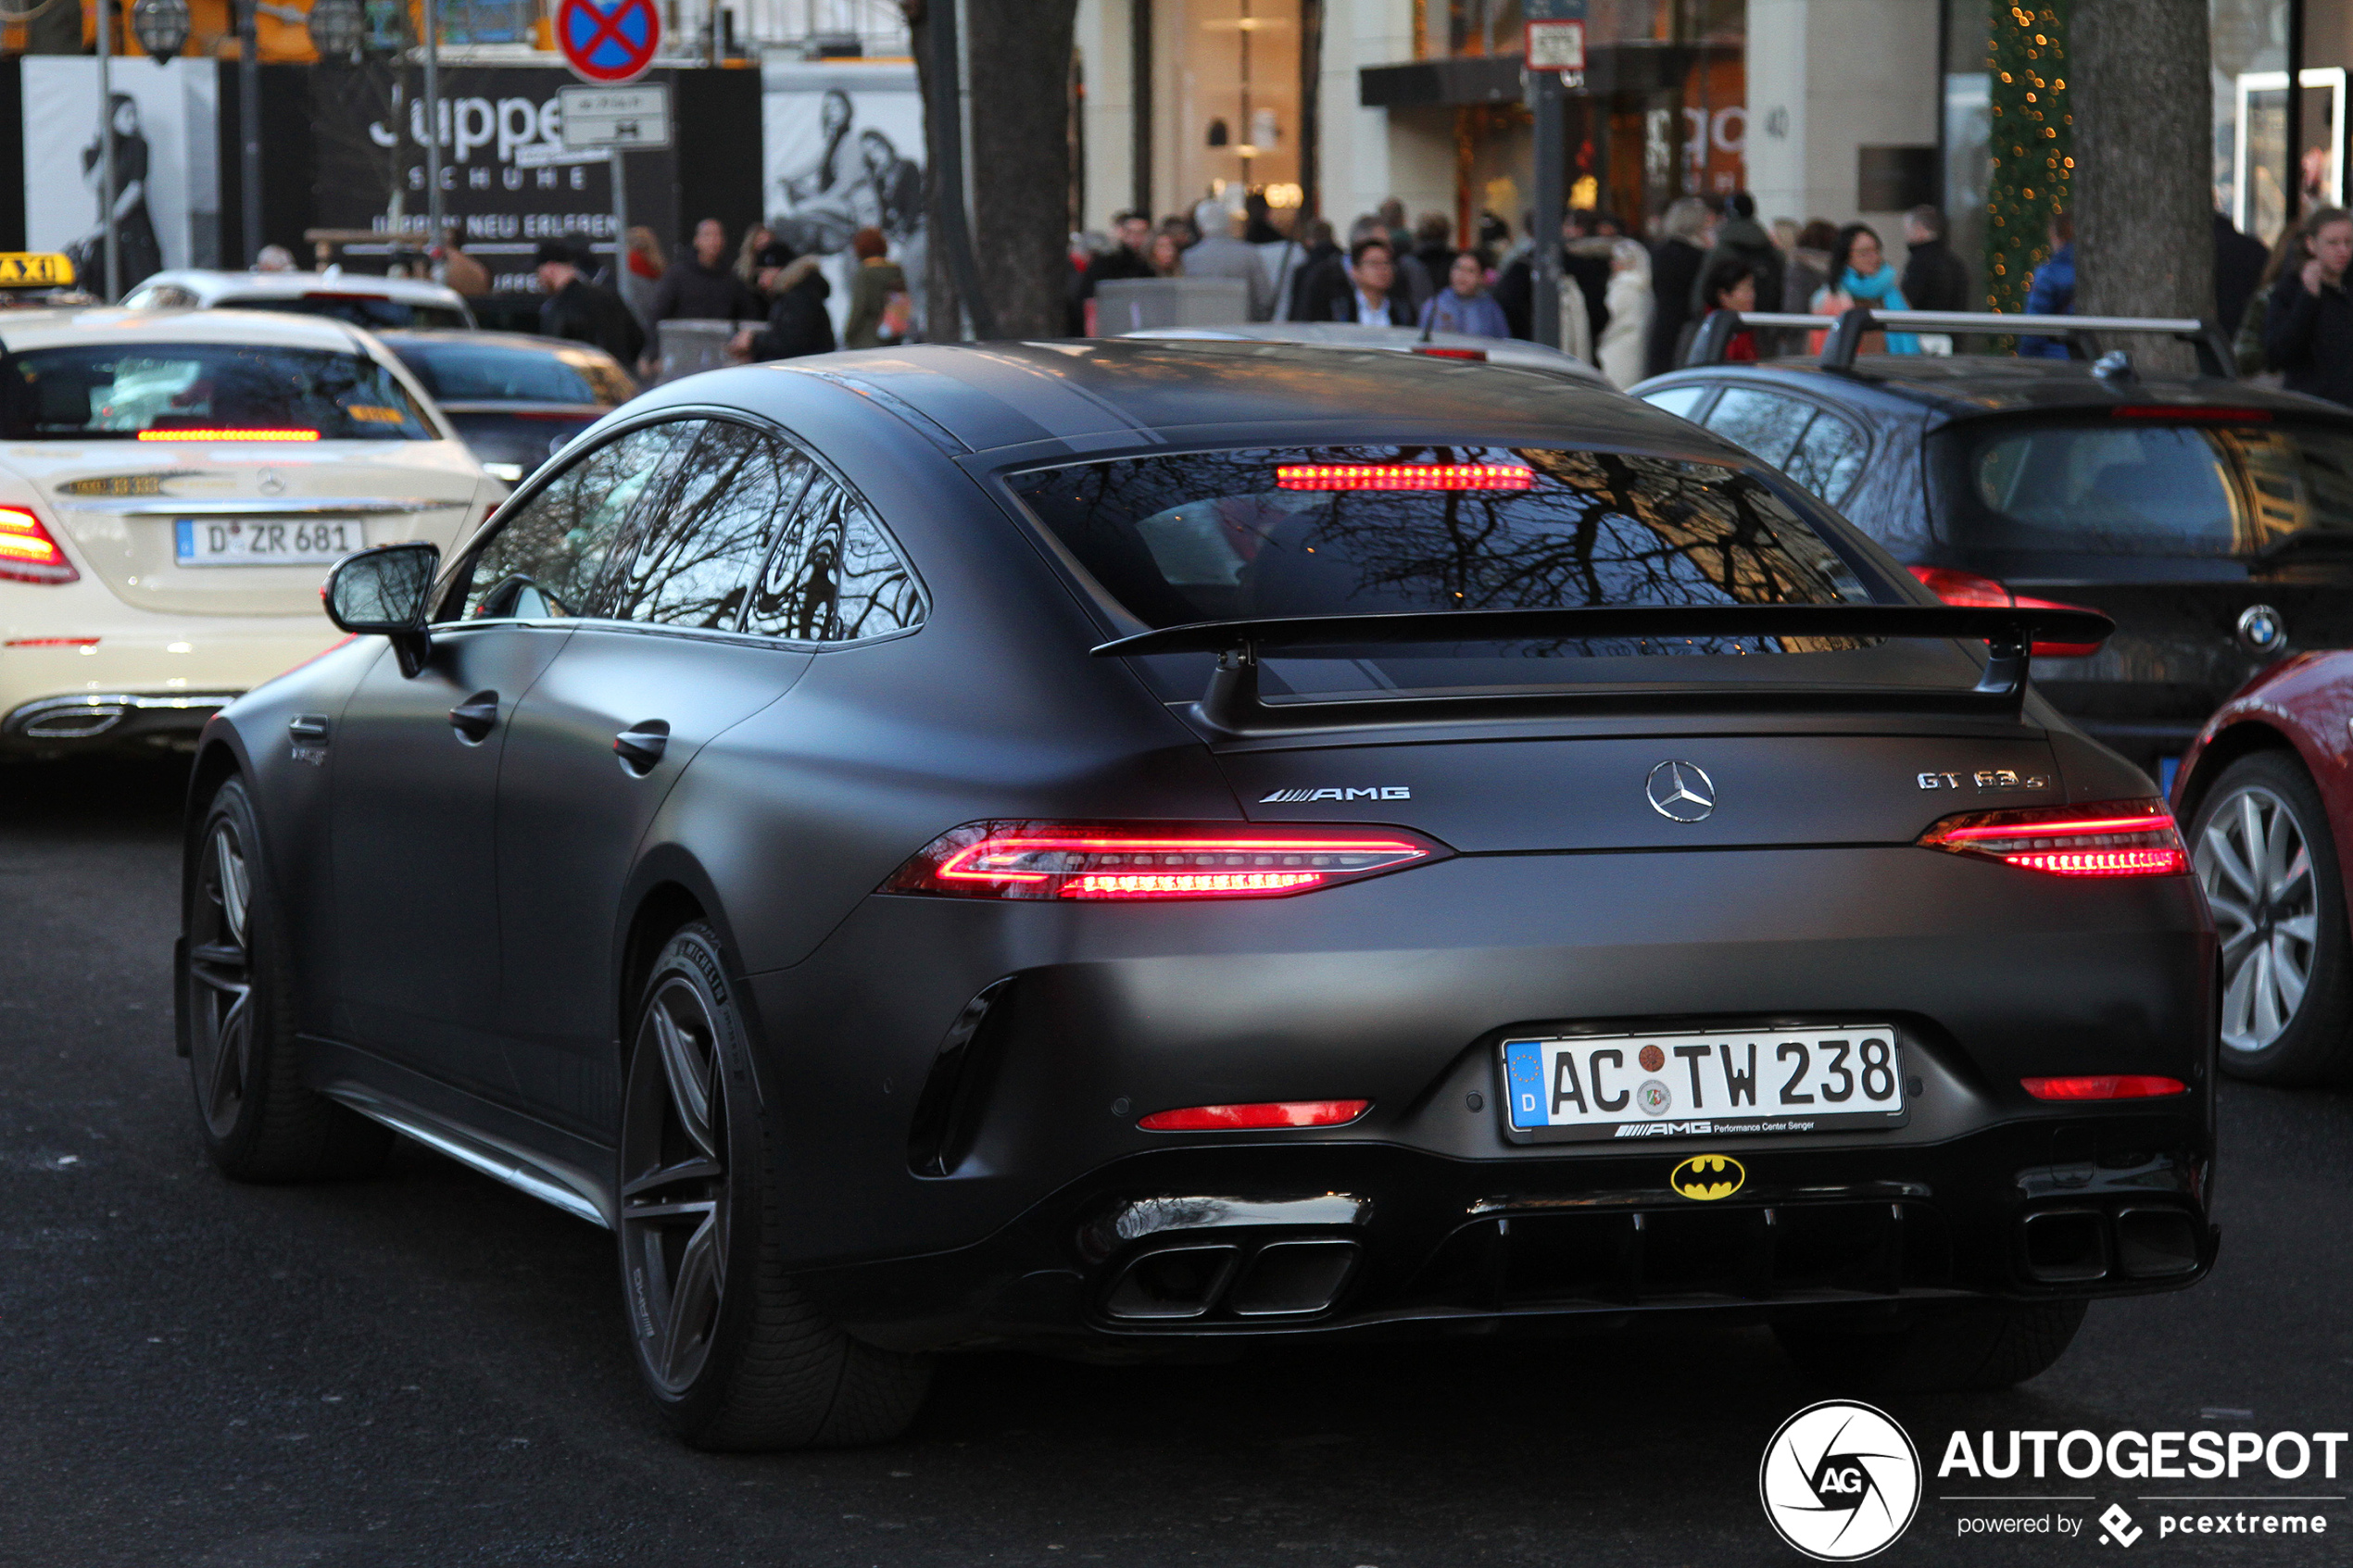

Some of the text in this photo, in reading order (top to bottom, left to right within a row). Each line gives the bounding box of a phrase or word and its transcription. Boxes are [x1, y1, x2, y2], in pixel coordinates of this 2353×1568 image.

[409, 166, 586, 190] SCHUHE
[466, 214, 520, 239] NEU
[0, 259, 55, 280] AXI
[249, 525, 286, 553] ZR
[296, 524, 348, 553] 681
[1917, 771, 1962, 789] GT
[1973, 770, 2020, 788] 63
[1308, 786, 1412, 803] AMG
[684, 941, 727, 1000] MICHELIN
[1552, 1048, 1629, 1115] AC
[1673, 1043, 1757, 1109] TW
[1776, 1038, 1895, 1106] 238
[1521, 1093, 1536, 1112] D
[1647, 1120, 1815, 1136] AMG Performance Center Senger
